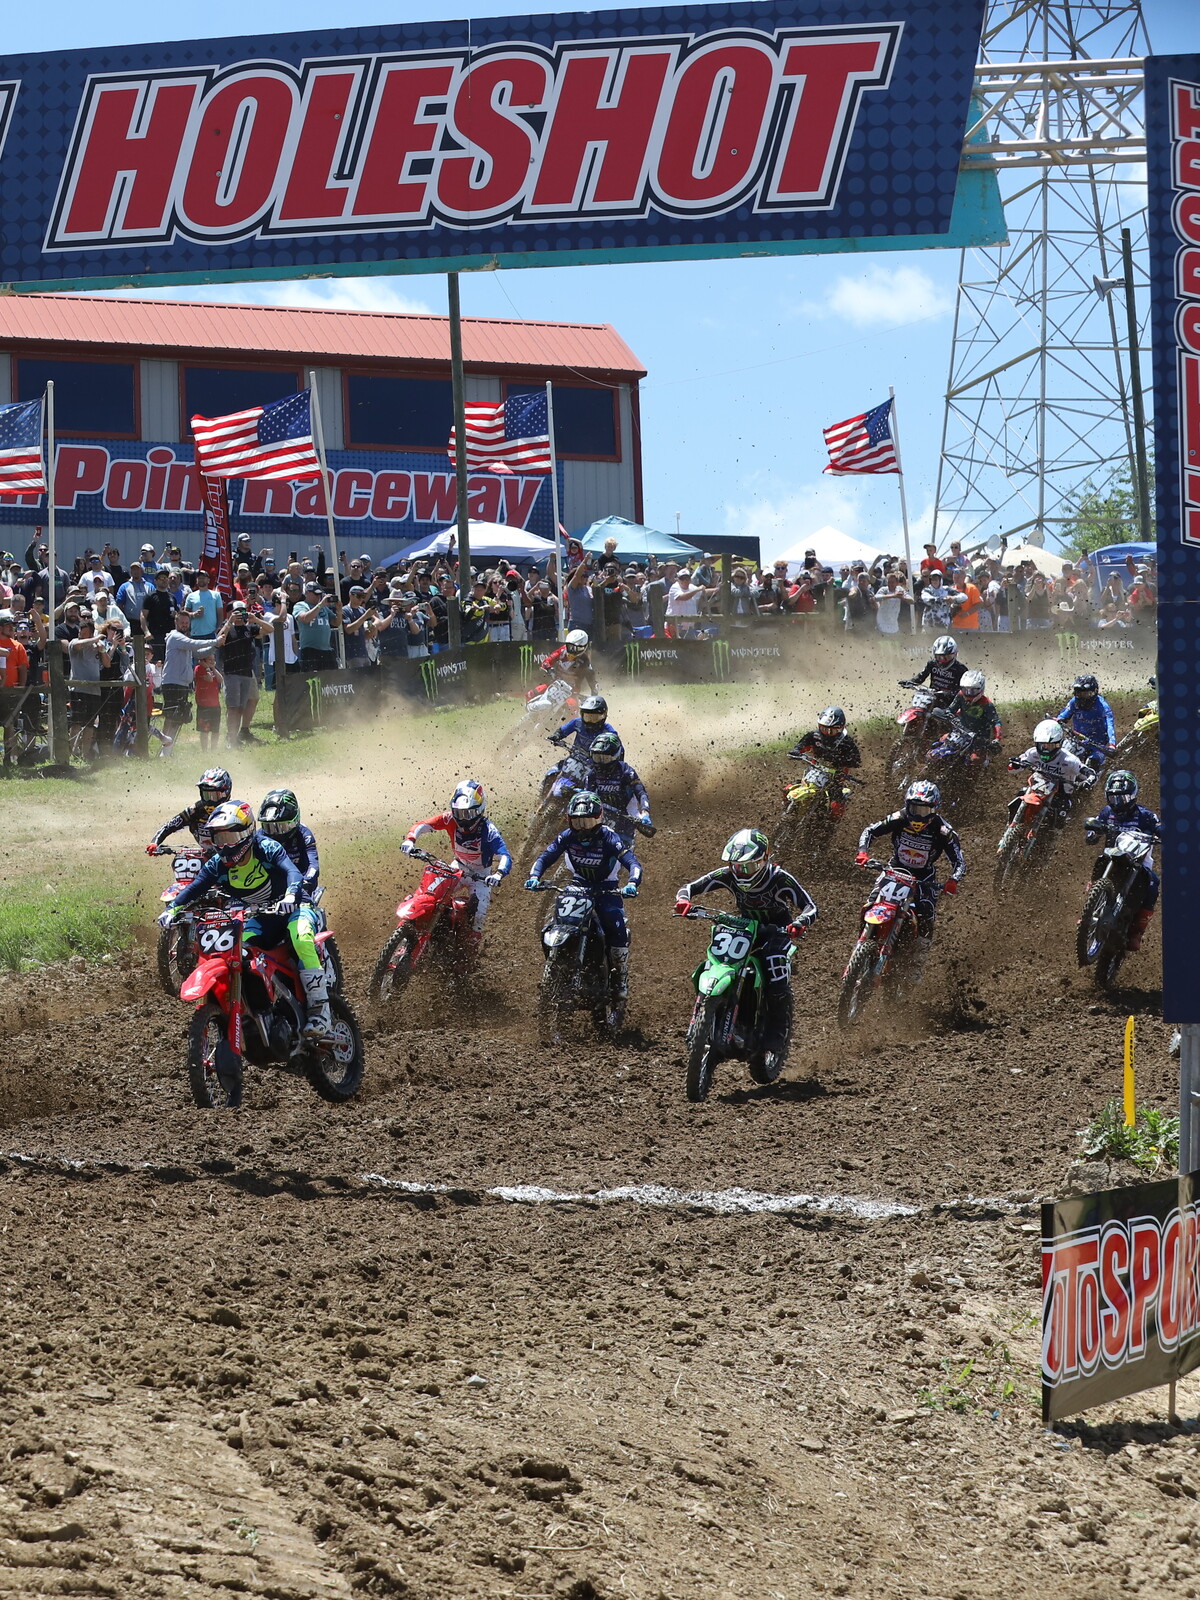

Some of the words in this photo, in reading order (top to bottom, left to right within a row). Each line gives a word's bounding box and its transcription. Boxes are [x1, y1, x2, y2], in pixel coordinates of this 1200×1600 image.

[44, 23, 902, 252] HOLESHOT
[49, 444, 233, 514] Poin
[239, 468, 546, 529] Raceway
[1081, 639, 1135, 650] MONSTER
[640, 649, 678, 660] MONSTER
[731, 647, 781, 658] MONSTER
[321, 683, 355, 697] MONSTER
[899, 838, 932, 850] GASGAS
[174, 858, 202, 873] 29
[571, 855, 602, 866] THOR
[427, 876, 447, 892] 1
[879, 881, 911, 902] 44
[557, 896, 593, 918] 32
[200, 929, 234, 953] 96
[711, 932, 750, 960] 30
